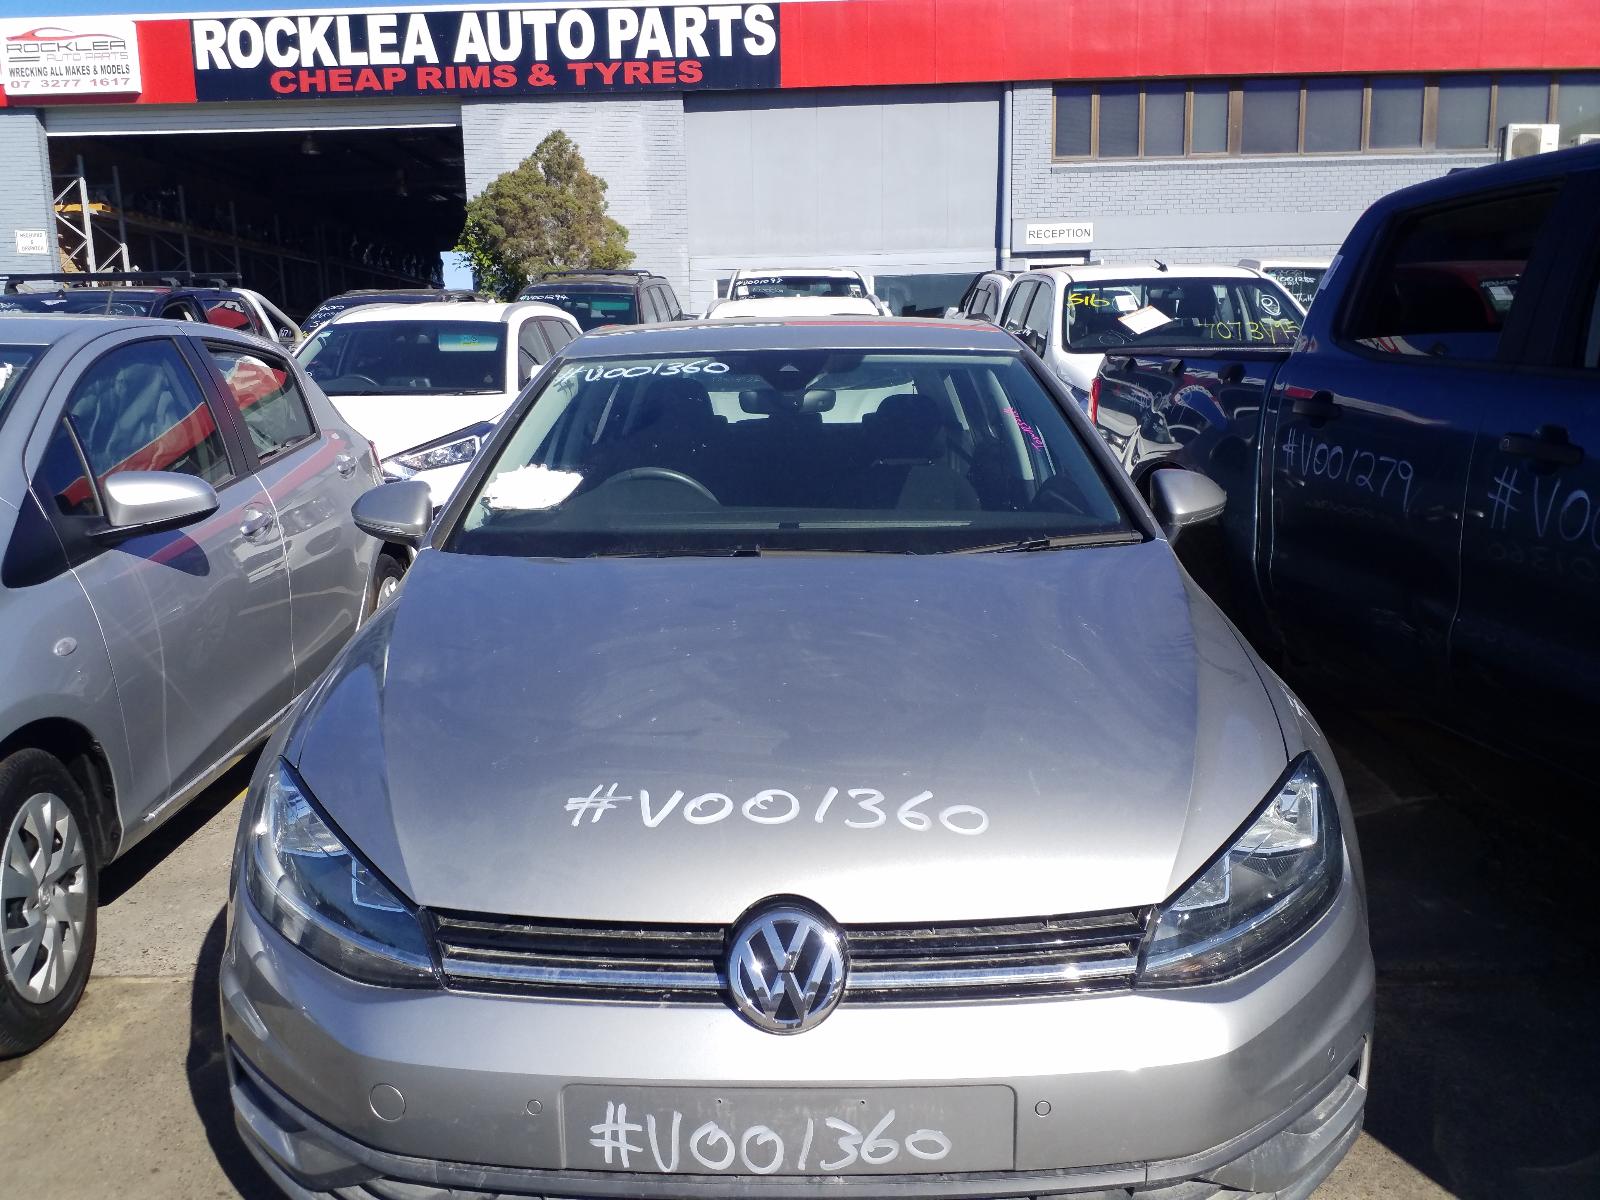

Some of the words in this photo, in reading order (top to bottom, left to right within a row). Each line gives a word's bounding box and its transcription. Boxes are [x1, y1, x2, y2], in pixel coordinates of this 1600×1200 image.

[6, 40, 126, 53] ROCKLEA
[193, 13, 440, 71] ROCKLEA
[453, 8, 596, 63] AUTO
[607, 3, 777, 60] PARTS
[46, 53, 82, 62] AUTO
[85, 51, 129, 61] PARTS
[9, 66, 48, 78] WRECKING
[50, 66, 63, 77] ALL
[65, 65, 91, 76] MAKES
[93, 65, 98, 75] &
[100, 63, 131, 75] MODELS
[270, 67, 407, 94] CHEAP
[416, 64, 518, 91] RIMS
[526, 62, 558, 87] &
[567, 60, 704, 87] TYRES
[10, 80, 31, 89] 07
[41, 79, 81, 88] 3277
[90, 77, 131, 87] 1617
[1028, 228, 1091, 239] RECEPTION
[1281, 427, 1414, 512] #V001279
[563, 782, 990, 836] #V001360
[589, 1101, 953, 1175] #V001360
